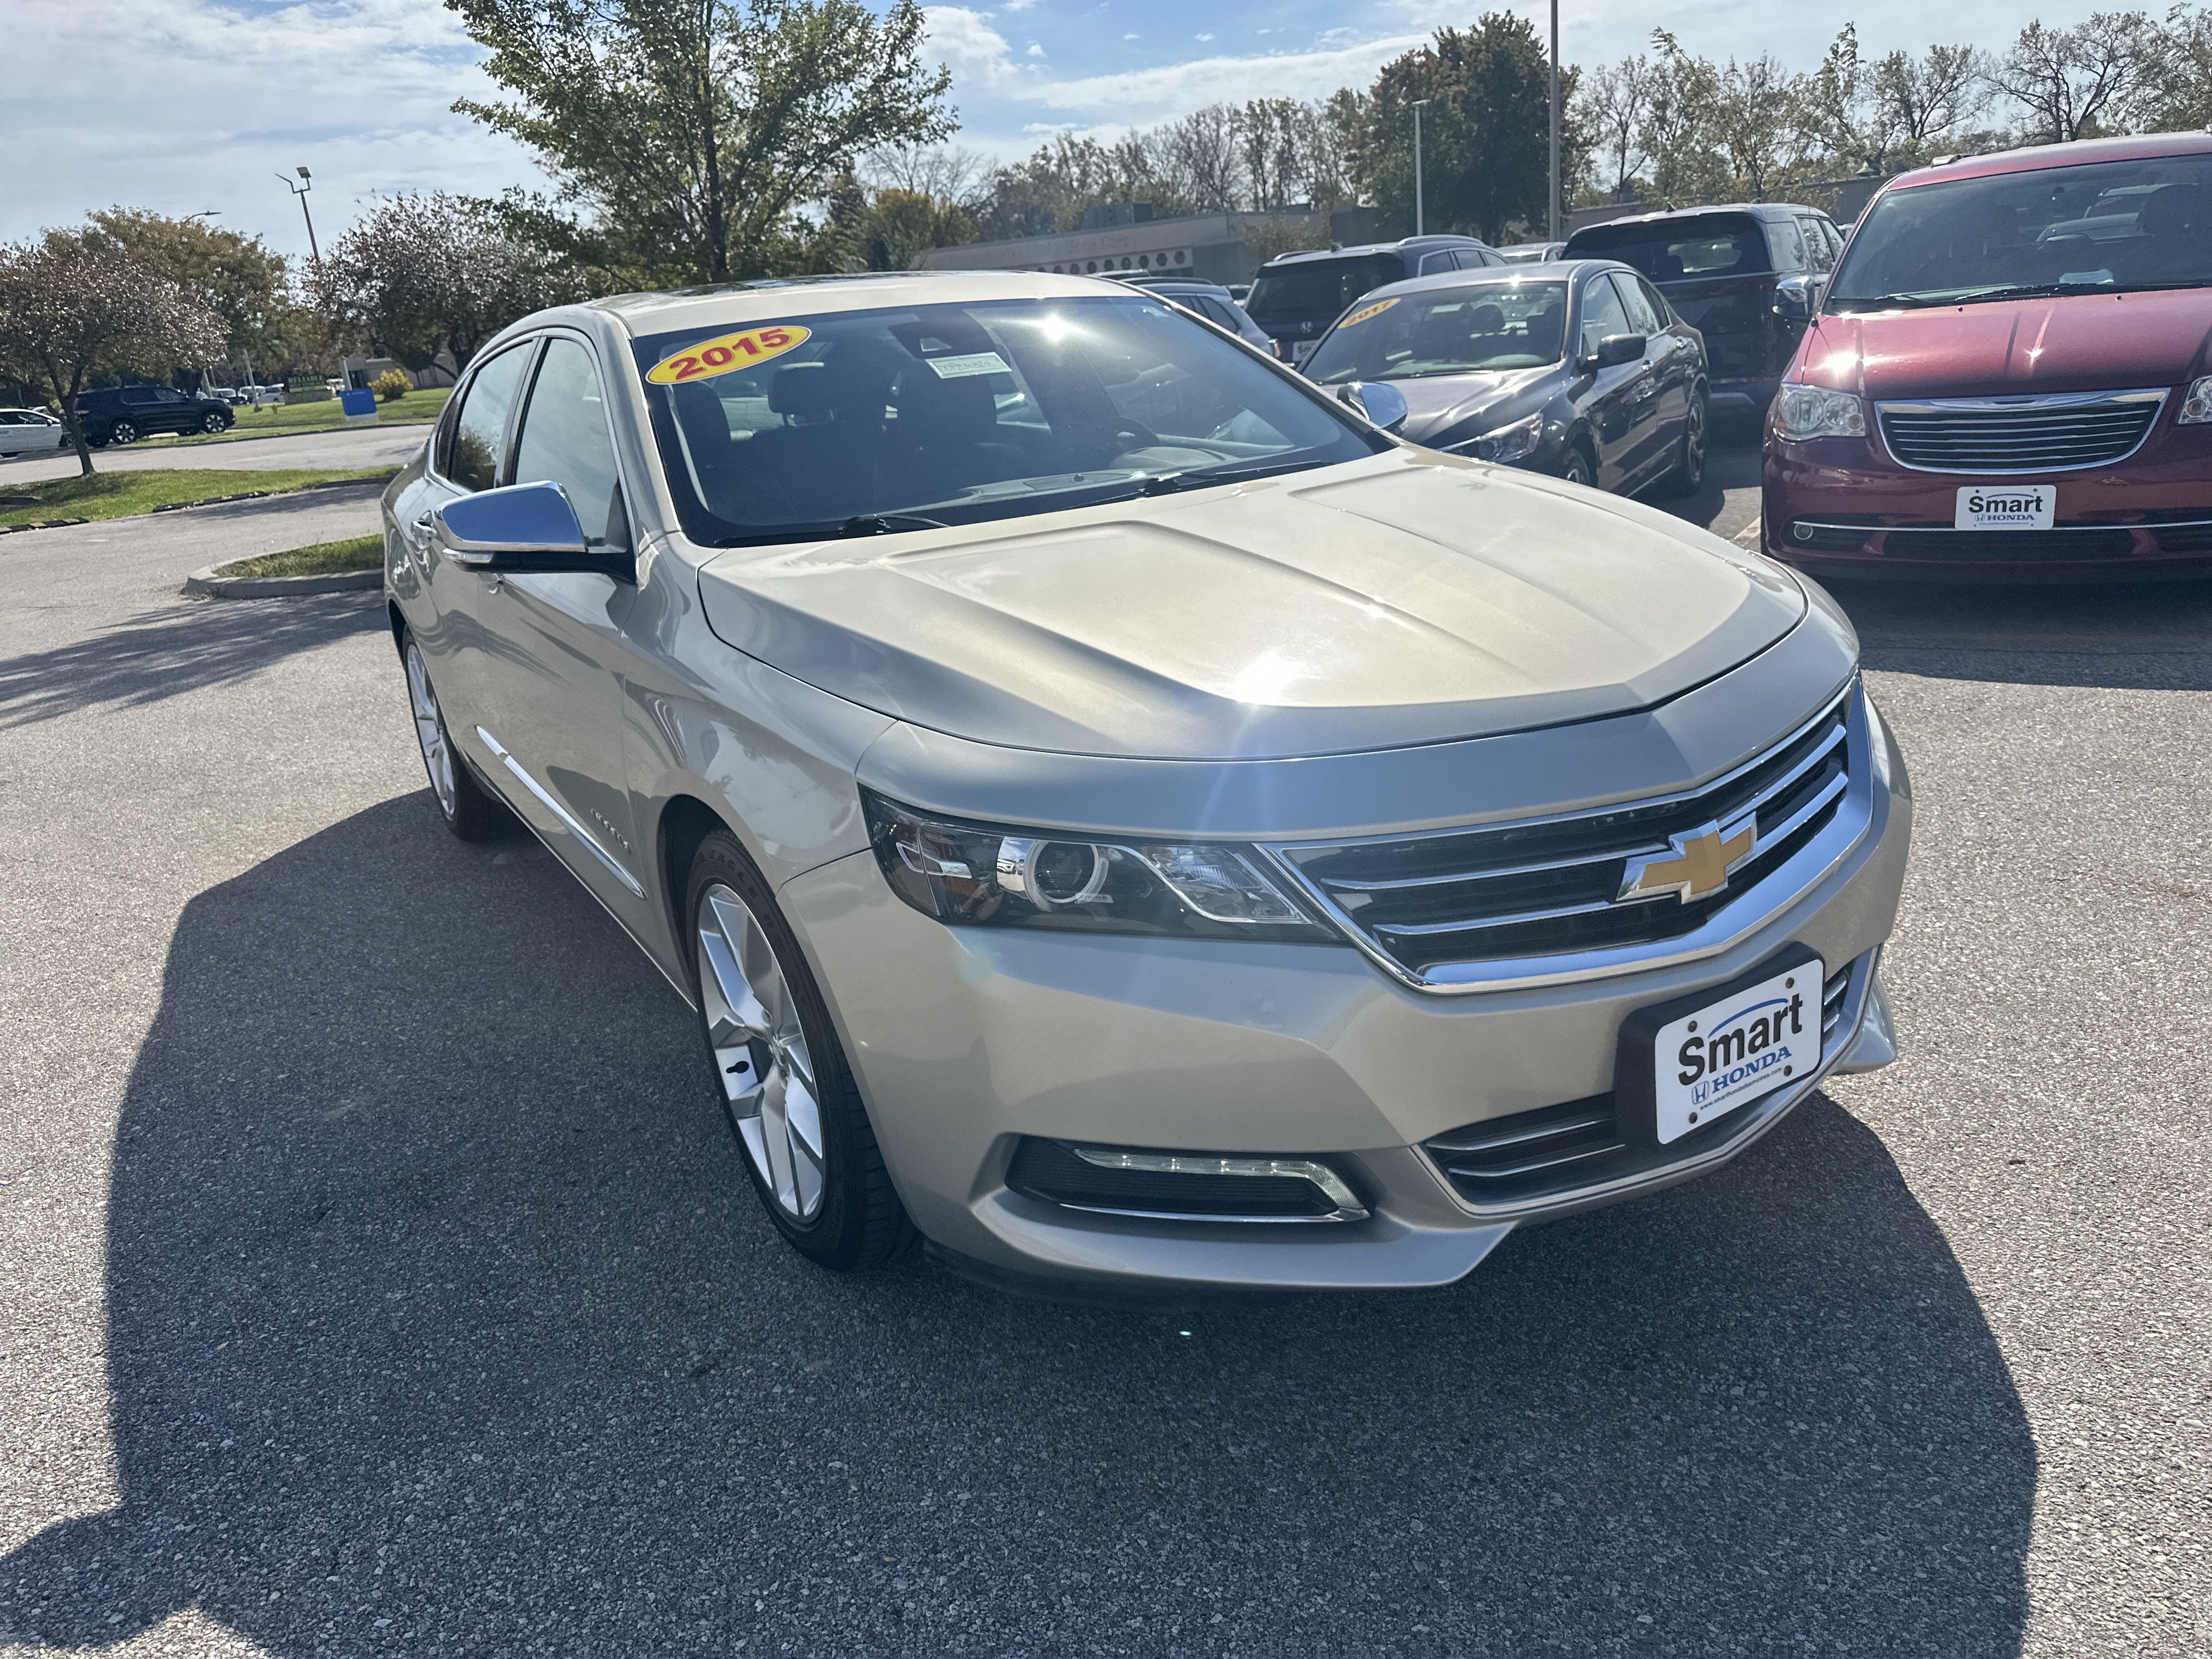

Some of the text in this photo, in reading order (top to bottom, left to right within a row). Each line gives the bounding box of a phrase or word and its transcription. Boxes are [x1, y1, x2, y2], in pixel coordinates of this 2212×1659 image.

[1346, 300, 1392, 326] 2017
[669, 328, 792, 381] 2015
[1968, 496, 2042, 512] Smart
[710, 851, 757, 899] EAGLE
[1678, 994, 1803, 1086] Smart
[1712, 1046, 1792, 1093] HONDA
